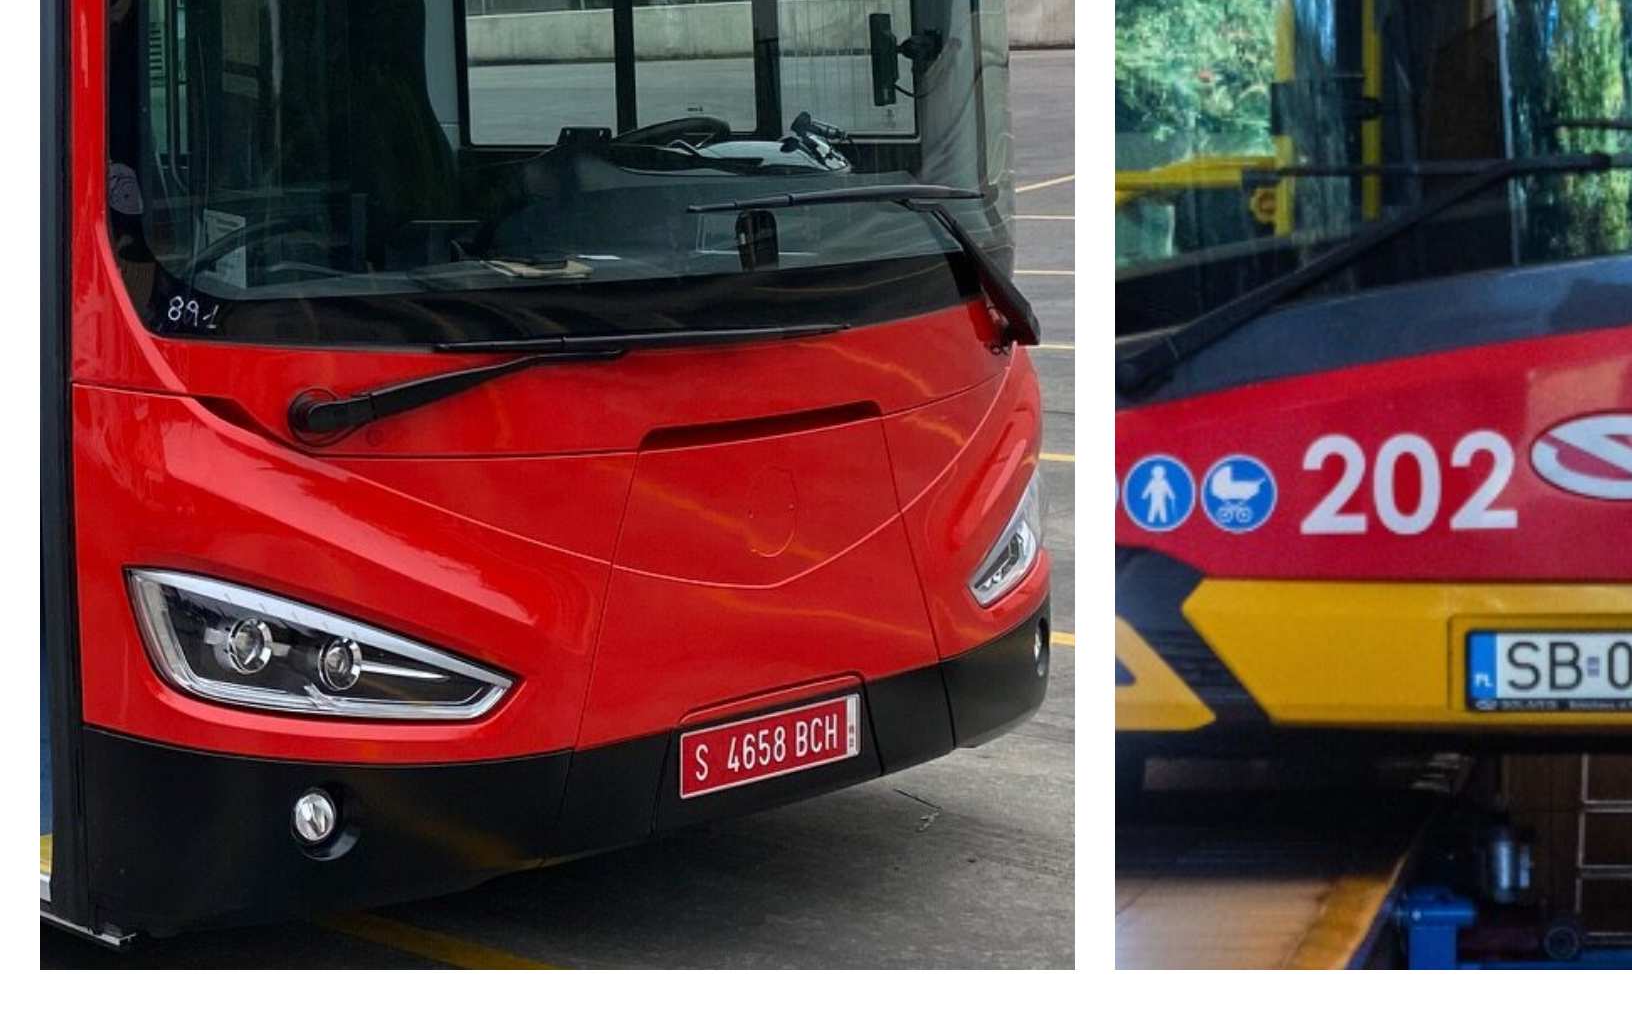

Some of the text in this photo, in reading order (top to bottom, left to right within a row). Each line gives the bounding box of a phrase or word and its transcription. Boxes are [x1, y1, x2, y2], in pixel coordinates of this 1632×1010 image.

[1300, 429, 1519, 536] 202
[726, 725, 787, 774] 4658
[795, 712, 839, 759] BCH
